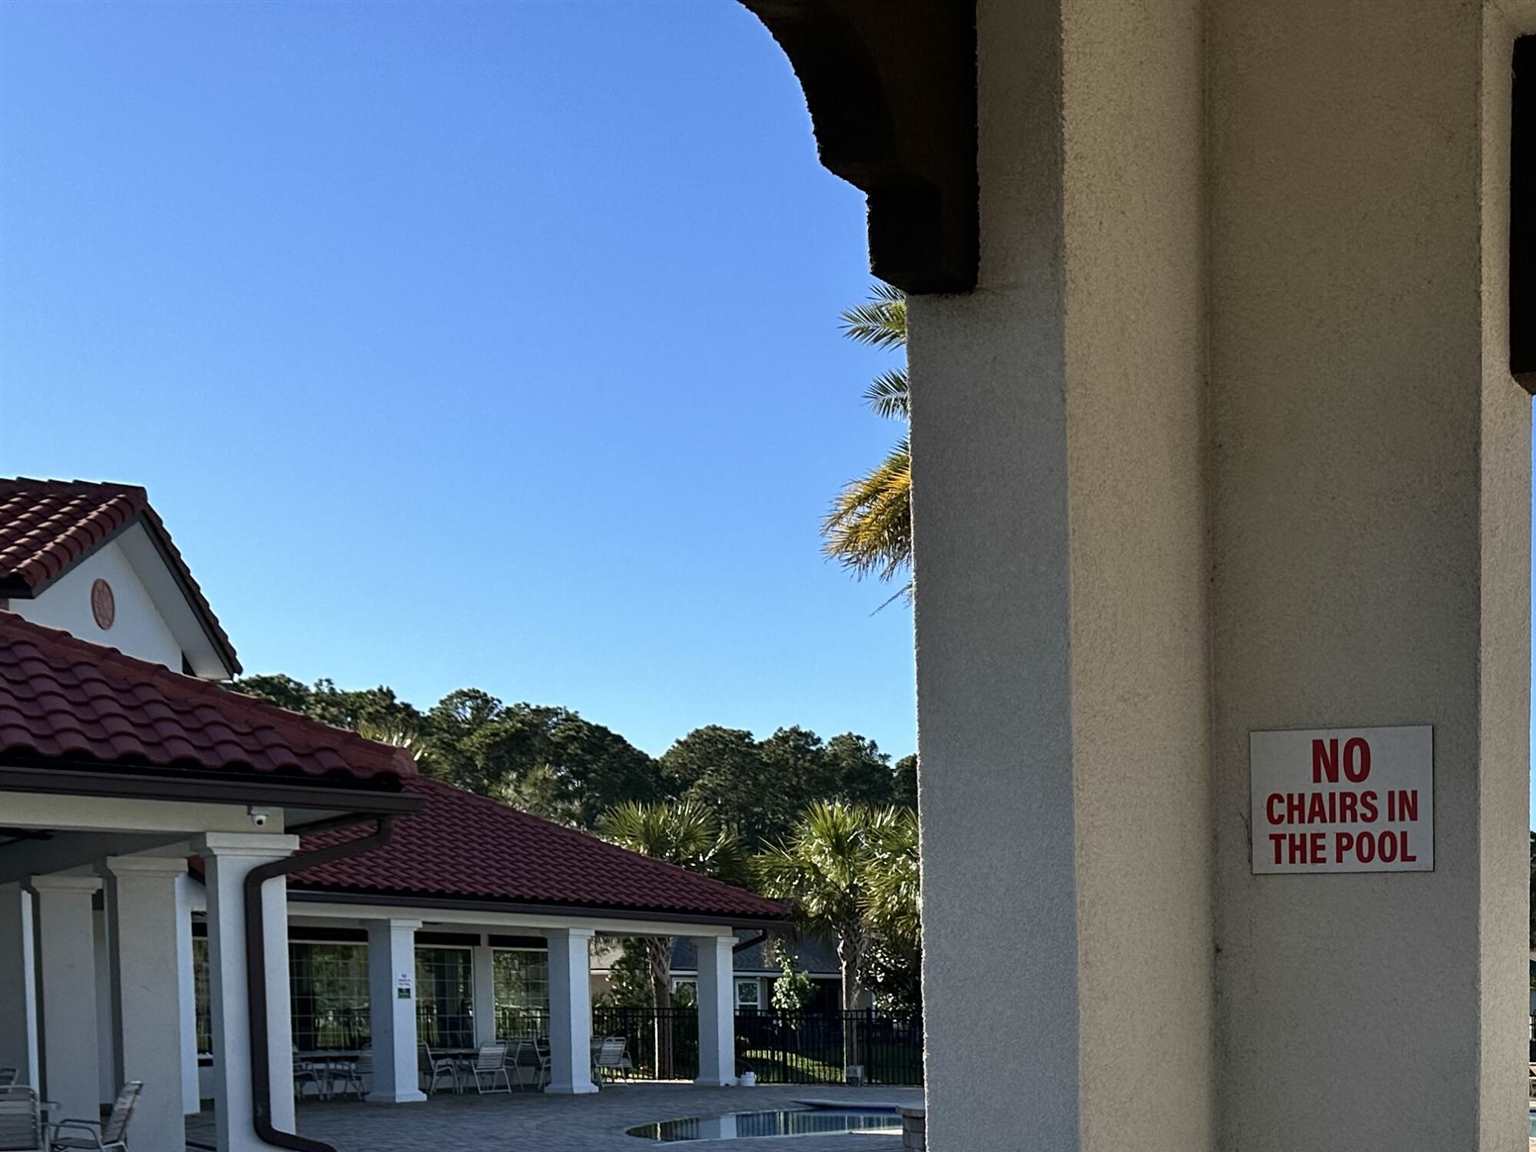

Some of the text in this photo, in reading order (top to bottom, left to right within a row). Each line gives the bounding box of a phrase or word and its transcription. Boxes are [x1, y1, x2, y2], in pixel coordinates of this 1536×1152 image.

[1312, 737, 1371, 783] NO
[1266, 790, 1418, 824] CHAIRS IN
[1269, 831, 1417, 864] THE POOL
